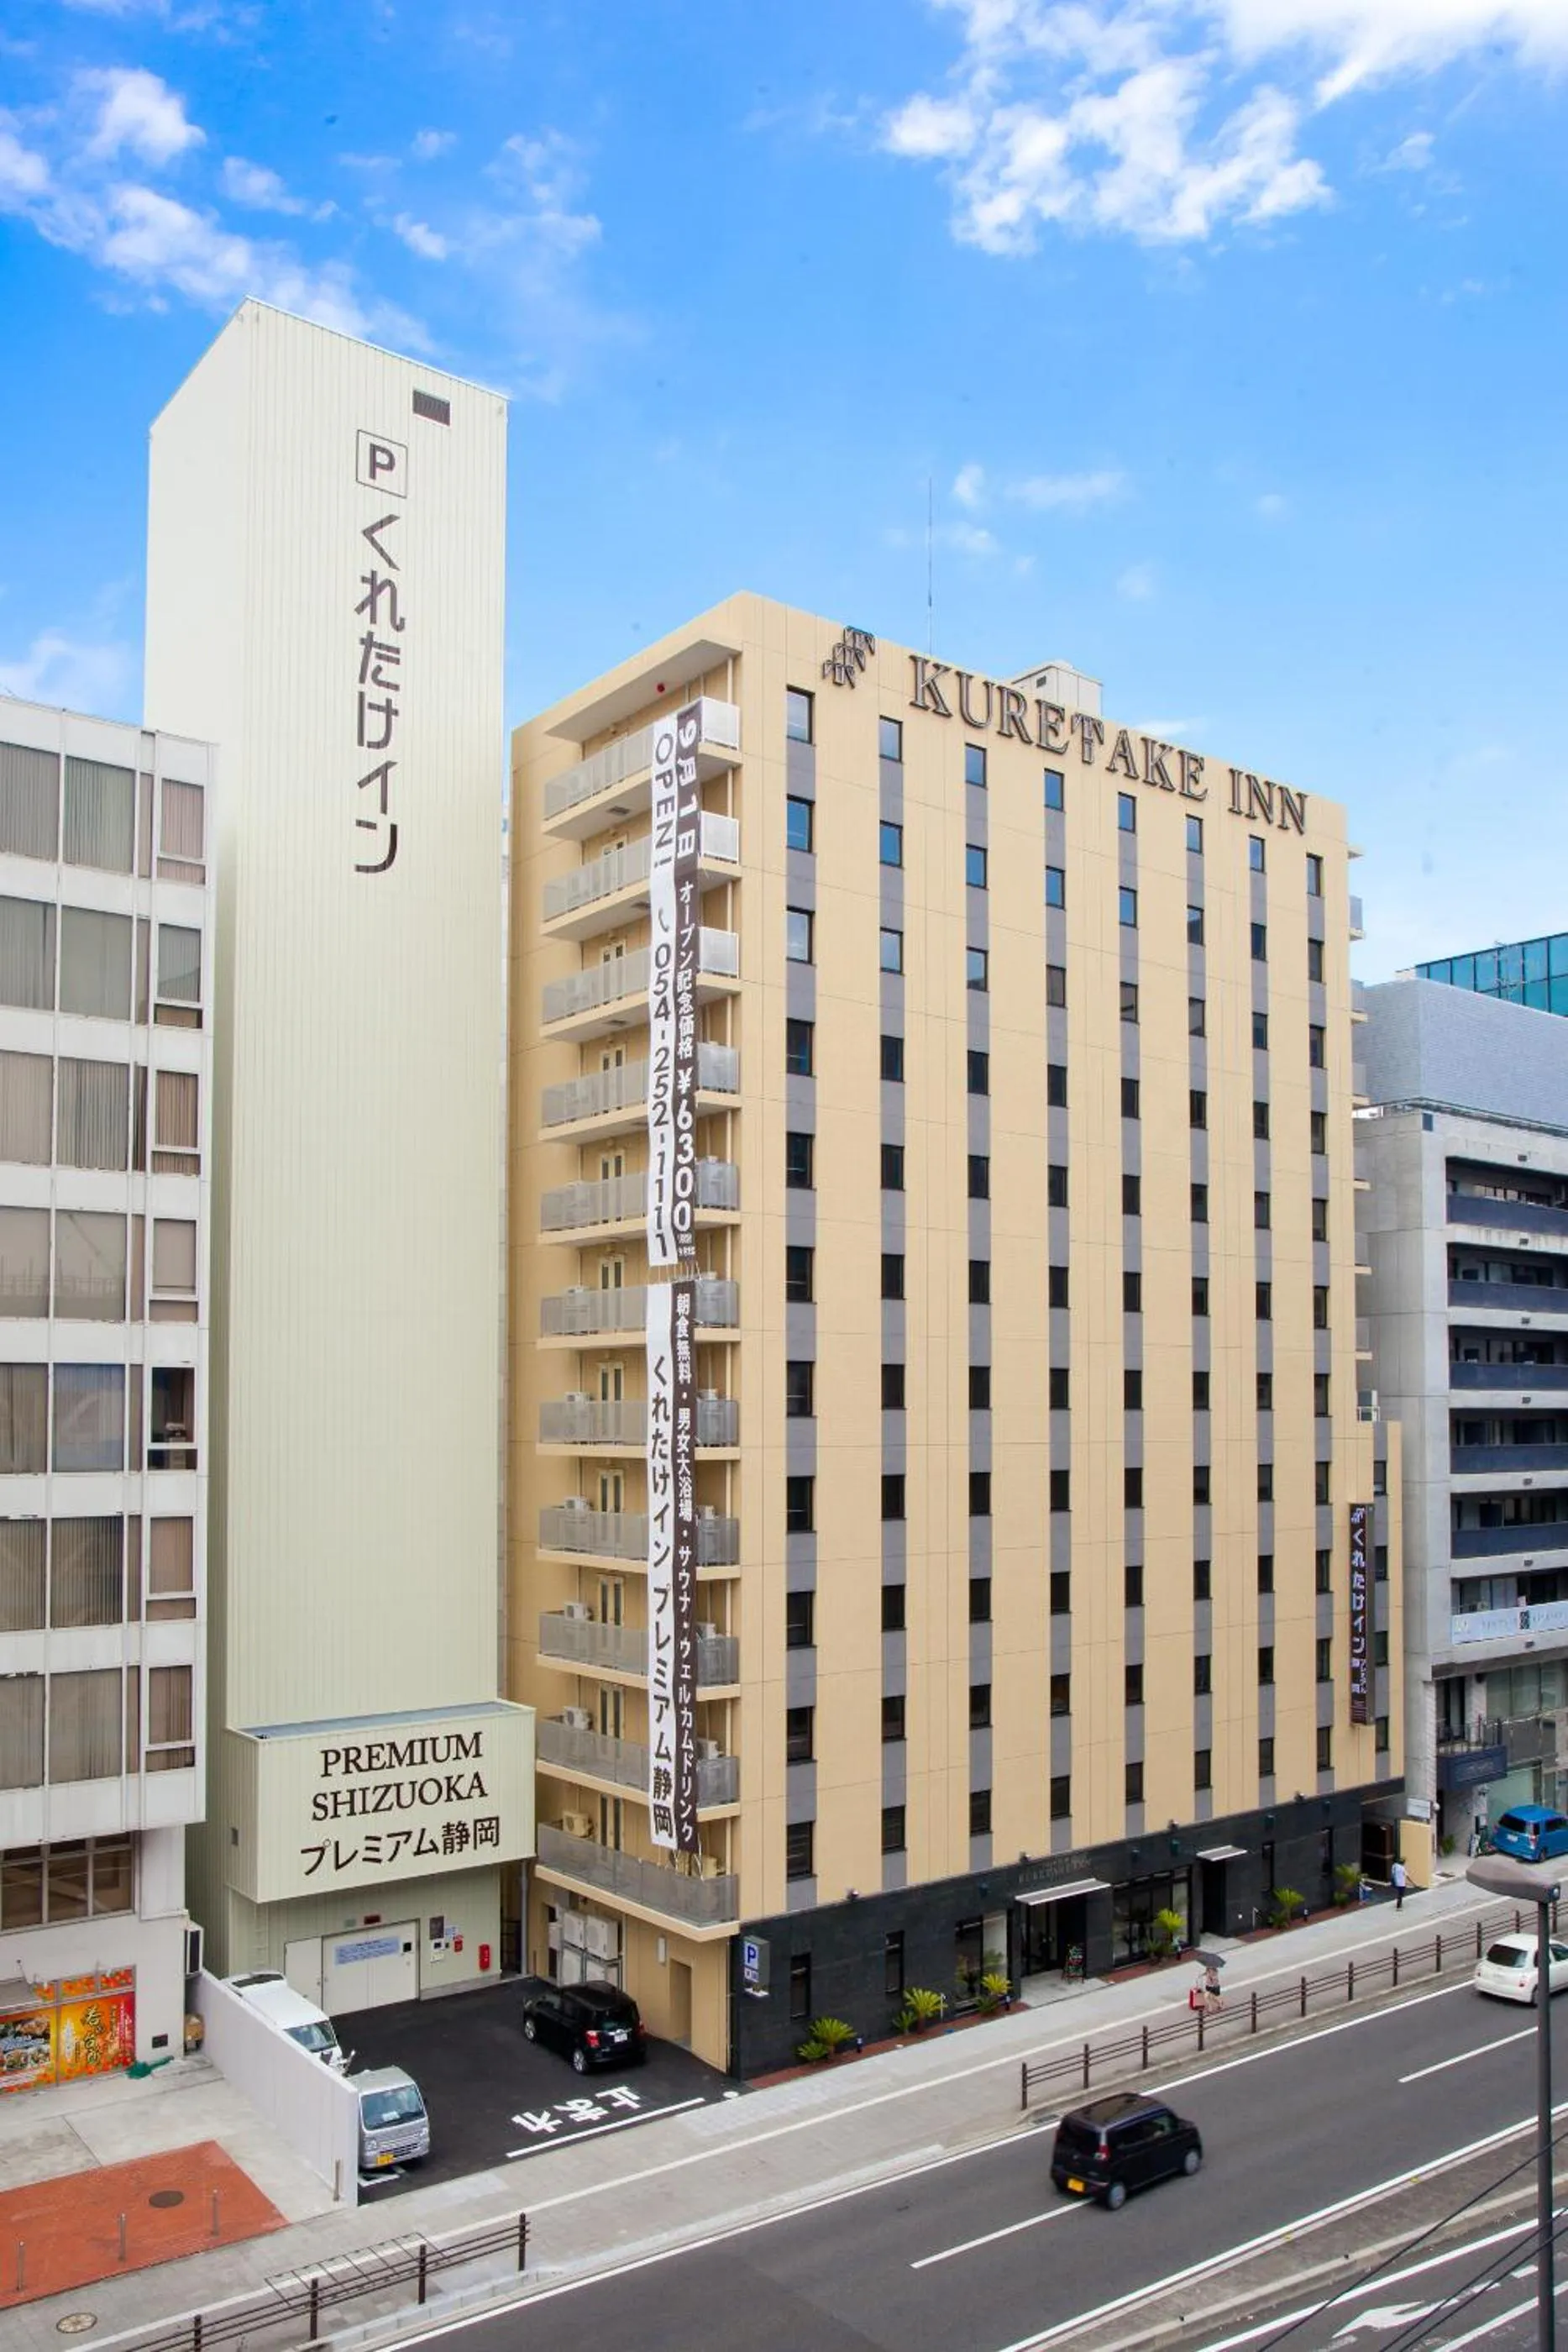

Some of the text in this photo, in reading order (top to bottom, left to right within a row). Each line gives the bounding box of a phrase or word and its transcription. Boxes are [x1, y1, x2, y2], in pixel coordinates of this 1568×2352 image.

[370, 443, 396, 480] P
[354, 513, 406, 874] くれたけイン
[909, 655, 1309, 836] KURETAKE INN
[653, 732, 674, 869] OPEN!
[652, 943, 672, 1257] 054-252-1111
[674, 1068, 694, 1232] ¥6300
[320, 1731, 484, 1778] PREMIUM
[311, 1771, 489, 1822] SHIZUOKA
[300, 1816, 501, 1877] プレミアム静岡
[747, 1945, 757, 1964] P
[511, 2086, 642, 2134] 止まれ
